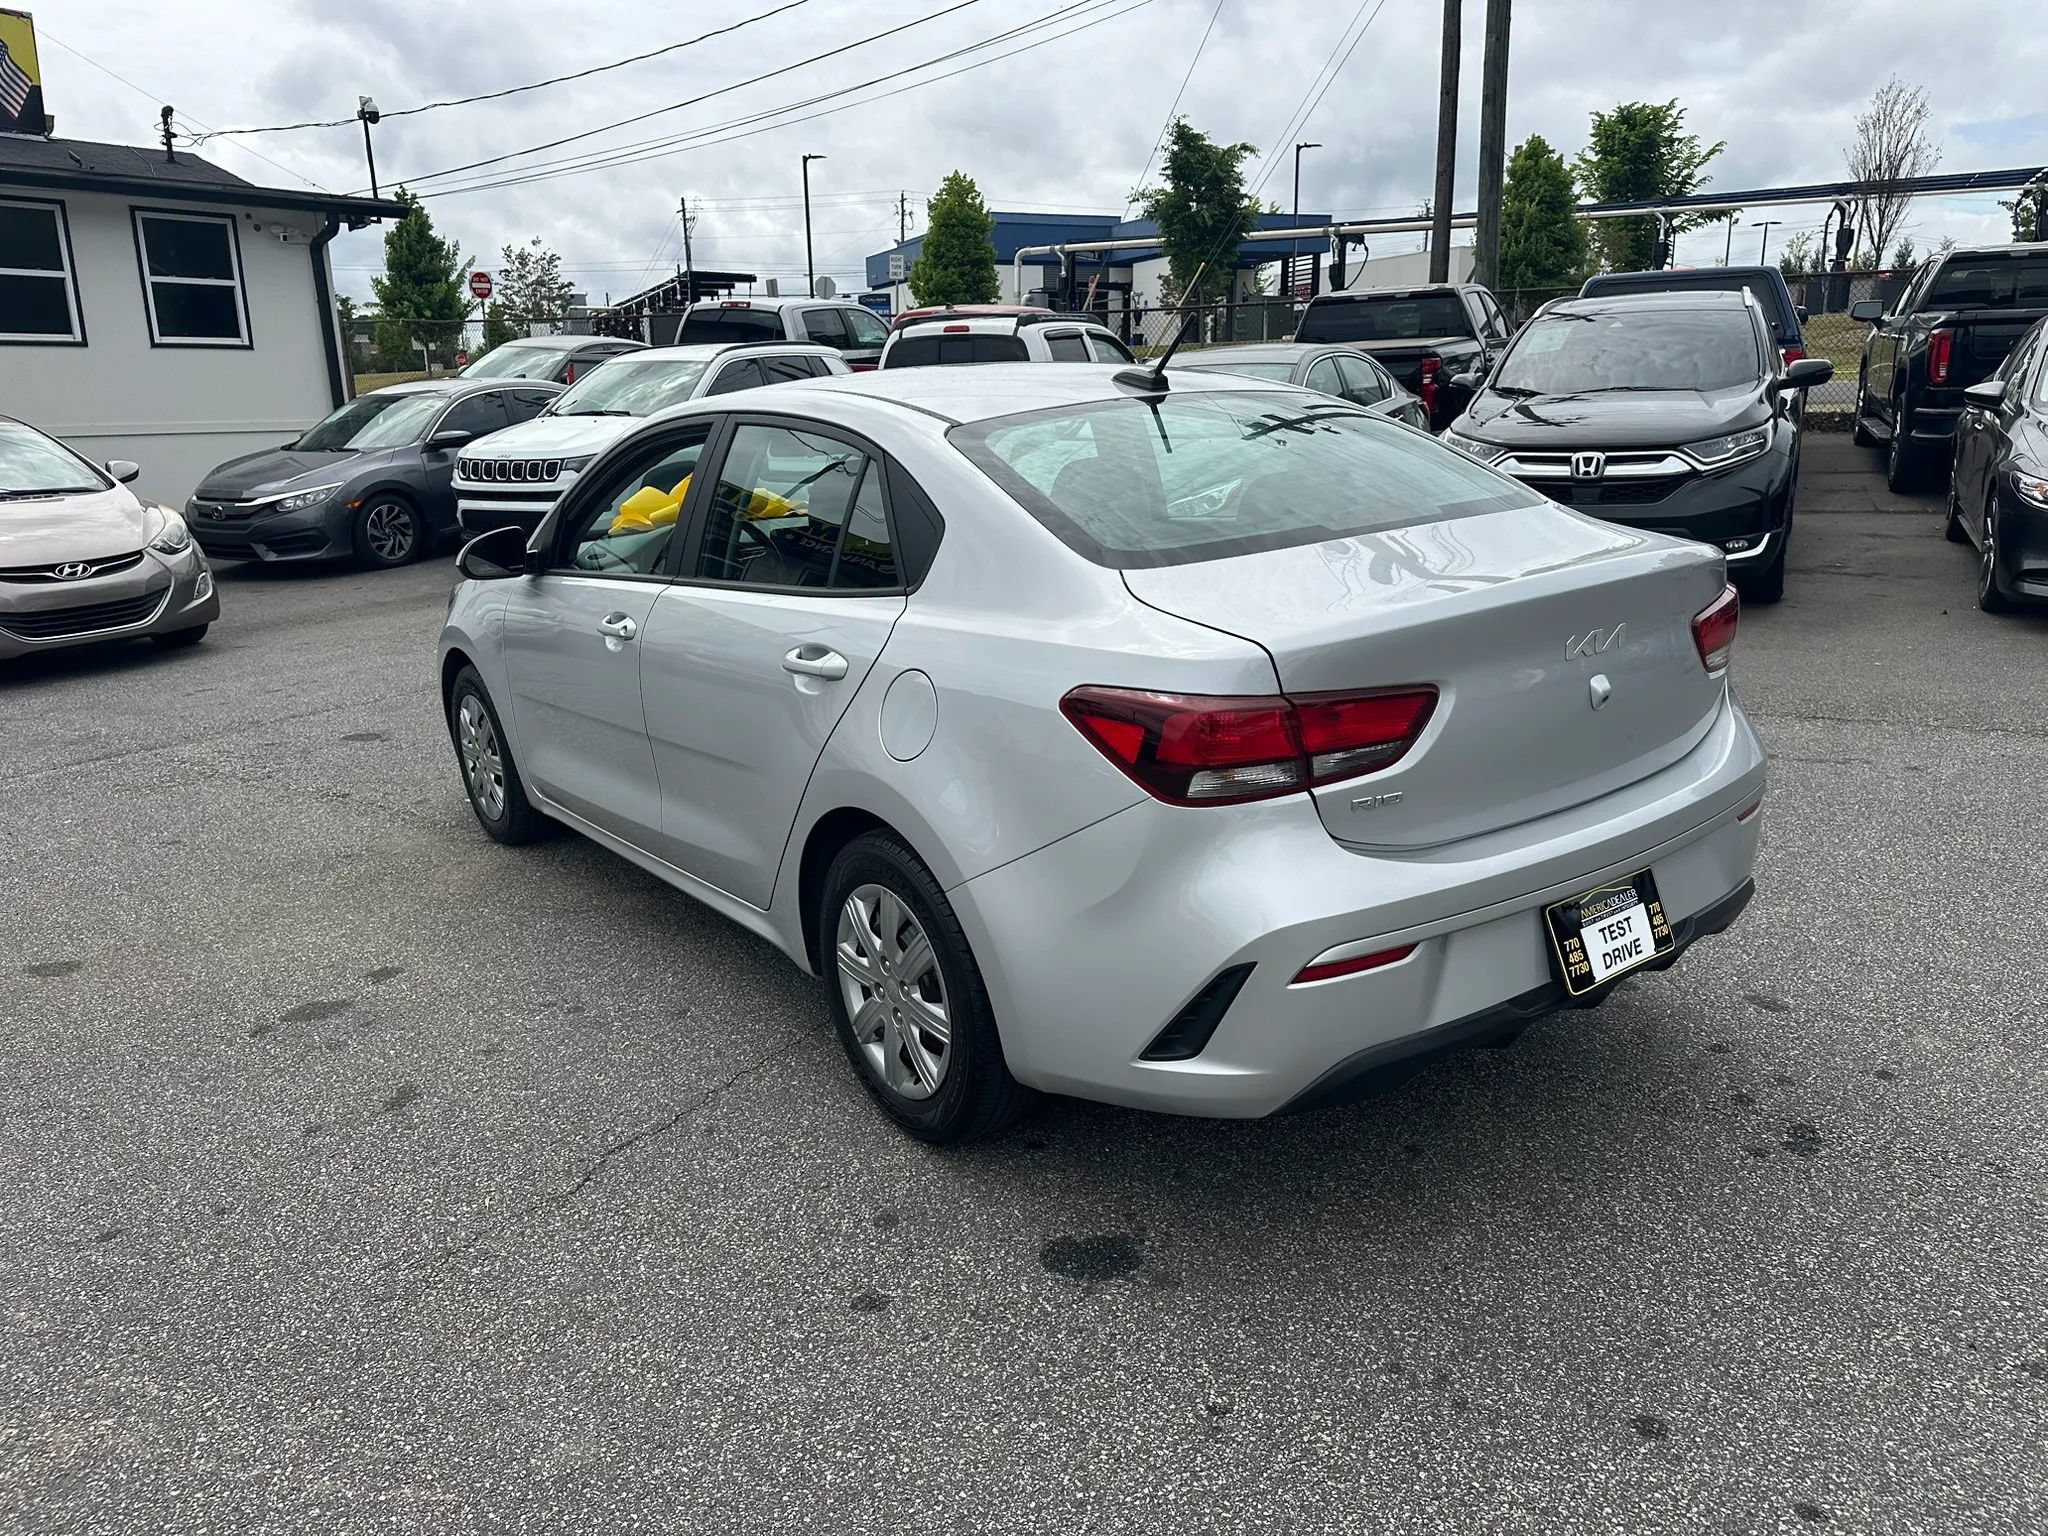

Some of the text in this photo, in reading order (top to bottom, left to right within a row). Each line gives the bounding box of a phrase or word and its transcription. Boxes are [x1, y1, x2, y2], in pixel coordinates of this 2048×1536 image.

[1350, 791, 1403, 812] RIO
[1648, 901, 1661, 915] 770
[1652, 912, 1664, 926] 485
[1598, 916, 1633, 945] TEST
[1653, 923, 1669, 939] 7730
[1563, 937, 1580, 952] 770
[1568, 949, 1584, 964] 485
[1602, 937, 1643, 970] DRIVE
[1568, 960, 1590, 978] 7730
